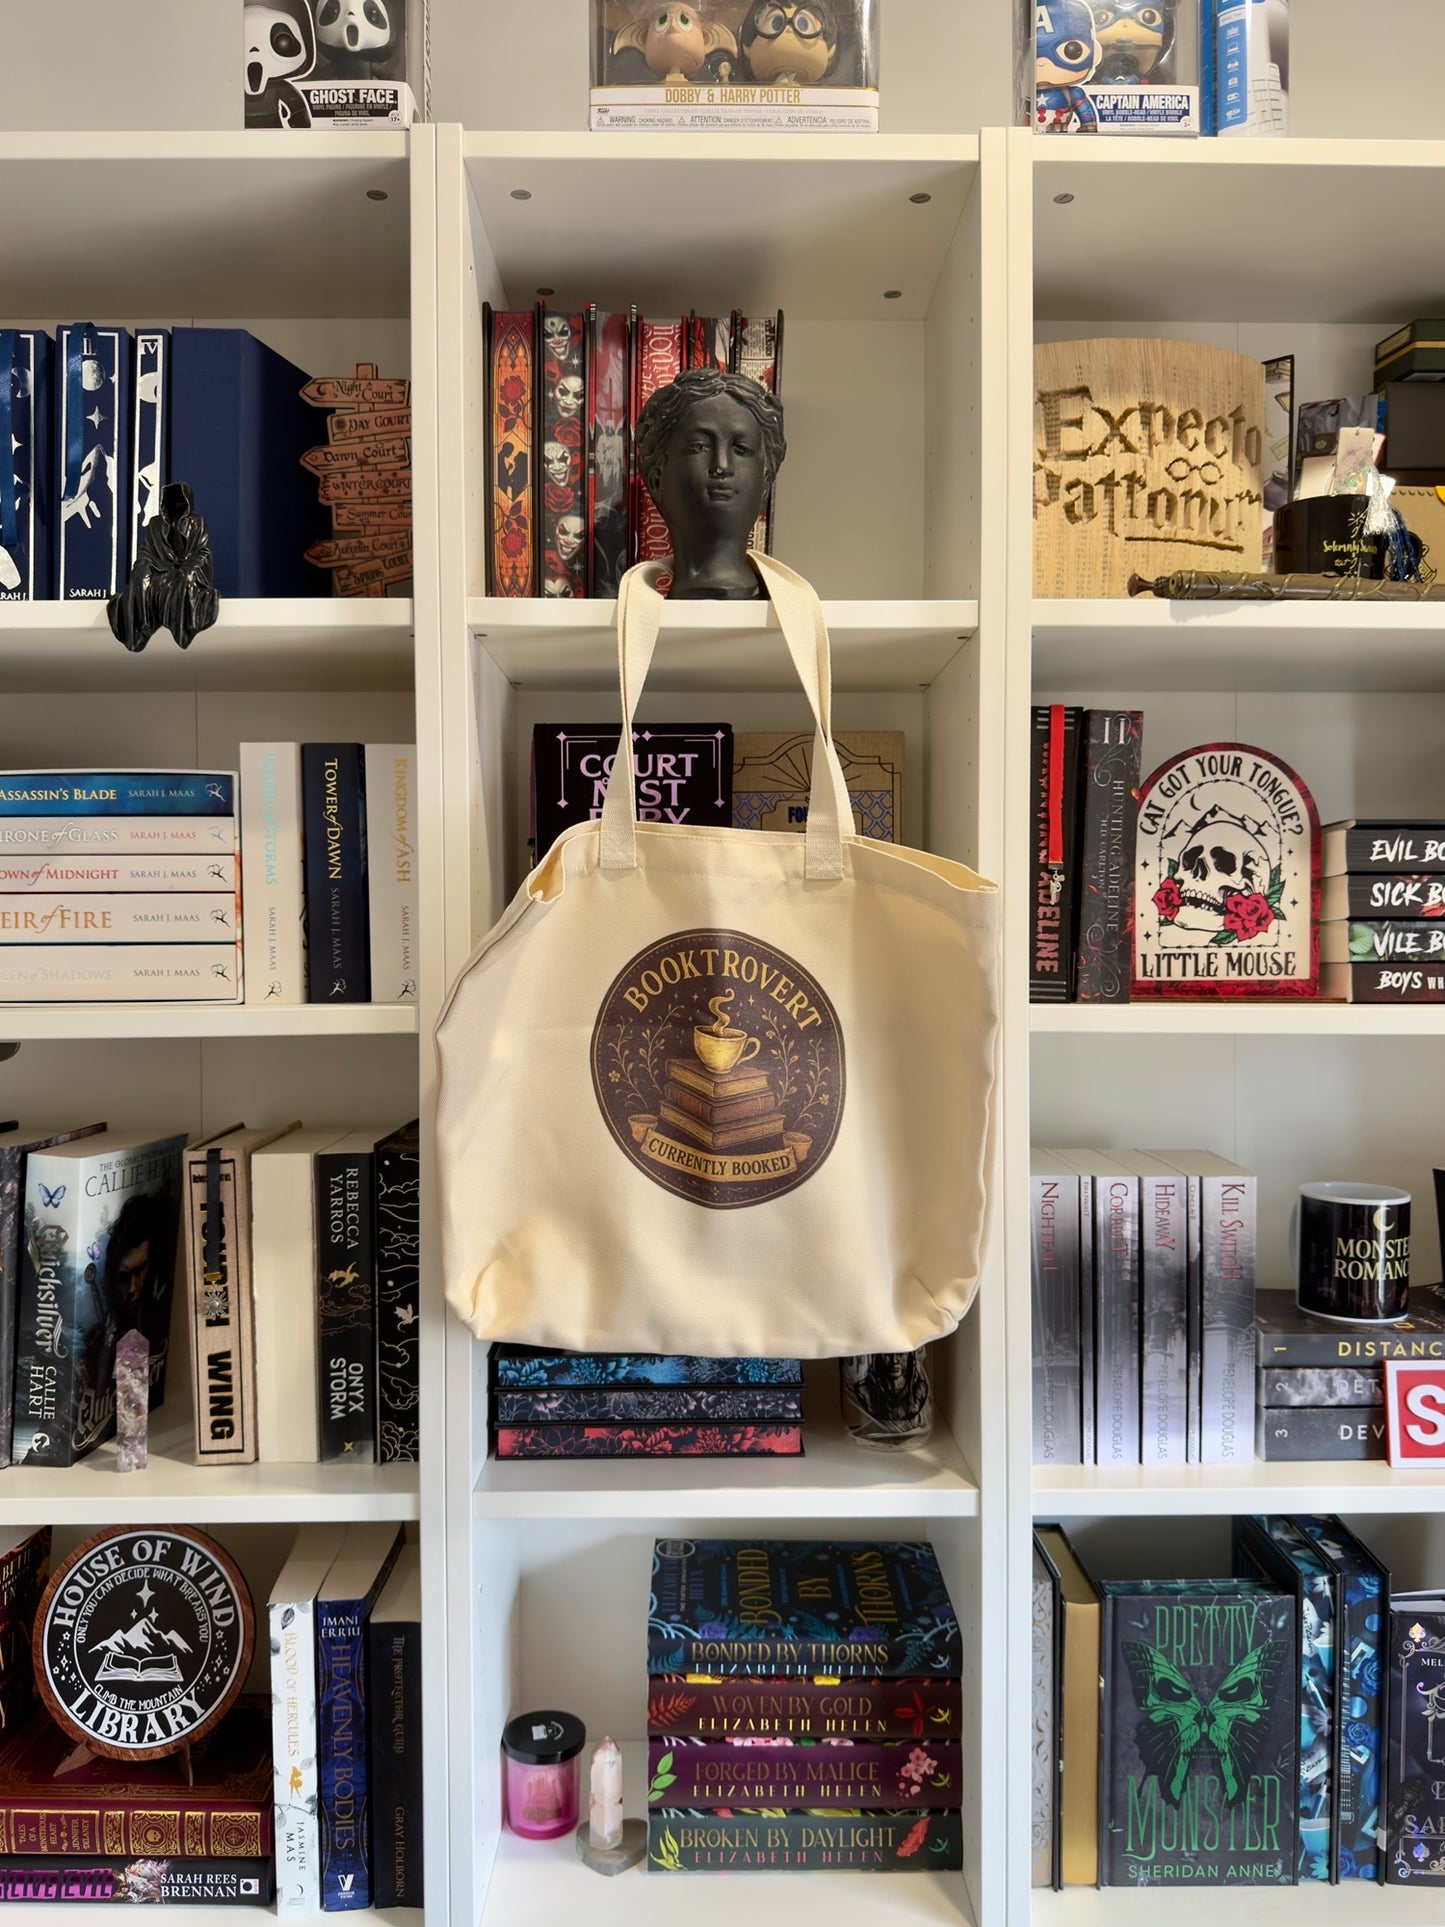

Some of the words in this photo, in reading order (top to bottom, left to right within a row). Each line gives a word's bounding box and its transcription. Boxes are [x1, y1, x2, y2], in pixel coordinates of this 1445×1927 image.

[310, 89, 355, 104] GHOST
[360, 89, 394, 104] FACE
[665, 88, 701, 103] DOBBY
[707, 88, 714, 103] &
[720, 88, 756, 103] HARRY
[760, 88, 800, 103] POTTER
[1096, 95, 1139, 109] CAPTAIN
[1142, 95, 1189, 109] AMERICA
[1035, 385, 1262, 468] Expecto
[323, 450, 358, 463] Dawn
[363, 446, 398, 459] Court
[69, 588, 101, 598] SARAH
[0, 788, 69, 801] ASSASSIN'S
[73, 789, 117, 800] BLADE
[128, 789, 159, 798] SARAH
[170, 789, 195, 798] MAAS
[323, 758, 338, 816] TOWER
[393, 758, 409, 832] KINGDOM
[1139, 800, 1167, 836] CAT
[1158, 765, 1191, 798] GOT
[1196, 754, 1243, 778] YOUR
[1248, 762, 1304, 836] TONGUE?
[323, 811, 344, 831] of
[1109, 780, 1124, 855] HUNTING
[68, 828, 119, 842] GLASS
[129, 832, 160, 840] SARAH
[170, 832, 197, 840] MAAS
[1370, 833, 1419, 863] EVIL
[327, 826, 342, 880] DAWN
[396, 848, 412, 884] ASH
[1093, 841, 1107, 889] CARLTON
[27, 863, 50, 886] of
[46, 869, 119, 880] MIDNIGHT
[130, 870, 161, 878] SARAH
[171, 870, 197, 878] MAAS
[330, 887, 340, 926] SARAH
[1106, 862, 1120, 933] ADELINE
[1370, 881, 1424, 908] SICK
[35, 905, 64, 934] of
[59, 909, 113, 929] FIRE
[133, 914, 164, 922] SARAH
[174, 914, 200, 922] MAAS
[268, 906, 276, 934] SARAH
[401, 905, 410, 935] SARAH
[332, 937, 342, 969] MAAS
[1373, 924, 1424, 958] VILE
[134, 969, 165, 977] SARAH
[174, 969, 200, 977] MAAS
[269, 946, 277, 971] MAAS
[402, 946, 411, 970] MAAS
[1140, 952, 1219, 977] LITTLE
[1225, 951, 1297, 977] MOUSE
[622, 948, 823, 1031] BOOKTROVERT
[1374, 970, 1423, 996] BOYS
[648, 1137, 727, 1176] CURRENTLY
[732, 1155, 791, 1176] BOOKED
[85, 1163, 143, 1198] CALLIE
[329, 1174, 344, 1244] YARROS
[346, 1167, 360, 1250] REBECCA
[1221, 1183, 1245, 1215] KILL
[1154, 1183, 1176, 1250] HIDEAWAY
[1219, 1219, 1244, 1281] SWITCH
[1337, 1340, 1444, 1357] DISTANC
[28, 1365, 44, 1419] HART
[43, 1366, 57, 1420] CALLIE
[207, 1350, 234, 1441] WING
[330, 1357, 346, 1420] STORM
[348, 1363, 364, 1413] ONYX
[1157, 1364, 1169, 1413] PENELOPE
[1223, 1362, 1236, 1411] PENELOPE
[1275, 1382, 1289, 1393] 2
[1336, 1379, 1379, 1393] DET
[1112, 1413, 1123, 1459] DOUGLAS
[1157, 1414, 1168, 1460] DOUGLAS
[1222, 1411, 1235, 1457] DOUGLAS
[1275, 1428, 1288, 1438] 3
[52, 1545, 126, 1628] HOUSE
[132, 1540, 172, 1562] OF
[180, 1546, 235, 1628] WIND
[737, 1548, 782, 1624] BONDED
[797, 1577, 832, 1598] BY
[851, 1551, 898, 1626] THORNS
[76, 1617, 89, 1644] ONLY
[83, 1599, 98, 1617] YOU
[95, 1579, 115, 1600] CAN
[114, 1567, 151, 1586] DECIDE
[153, 1568, 182, 1587] WHAT
[199, 1622, 209, 1643] YOU
[320, 1627, 361, 1638] ERRIU
[322, 1616, 359, 1628] IMANI
[1153, 1600, 1260, 1667] PRETTY
[691, 1641, 771, 1662] BONDED
[776, 1642, 802, 1662] BY
[806, 1643, 889, 1664] THORNS
[93, 1683, 118, 1705] CLIMB
[119, 1697, 137, 1711] THE
[139, 1684, 184, 1710] MOUNTAIN
[330, 1643, 354, 1760] HEAVENLY
[712, 1694, 790, 1715] WOVEN
[789, 1695, 813, 1715] BY
[819, 1696, 873, 1716] GOLD
[69, 1687, 206, 1744] LIBRARY
[286, 1694, 300, 1757] HERCULES
[698, 1717, 812, 1732] ELIZABETH
[826, 1718, 888, 1733] HELEN
[695, 1762, 771, 1782] FORGED
[775, 1762, 801, 1782] BY
[806, 1761, 880, 1782] MALICE
[692, 1784, 806, 1798] ELIZABETH
[820, 1784, 882, 1798] HELEN
[332, 1765, 356, 1850] BODIES
[394, 1806, 405, 1837] GRAY
[1120, 1773, 1281, 1862] MONSTER
[18, 1823, 26, 1844] TALES
[49, 1822, 58, 1845] HEART
[286, 1832, 296, 1863] MAS
[296, 1821, 306, 1871] JASMINE
[679, 1827, 759, 1848] BROKEN
[766, 1827, 793, 1848] BY
[801, 1827, 897, 1848] DAYLIGHT
[160, 1873, 203, 1884] SARAH
[206, 1873, 237, 1884] REES
[395, 1840, 406, 1898] HOLBORN
[1128, 1863, 1219, 1879] SHERIDAN
[1227, 1863, 1274, 1879] ANNE
[160, 1885, 237, 1897] BRENNAN
